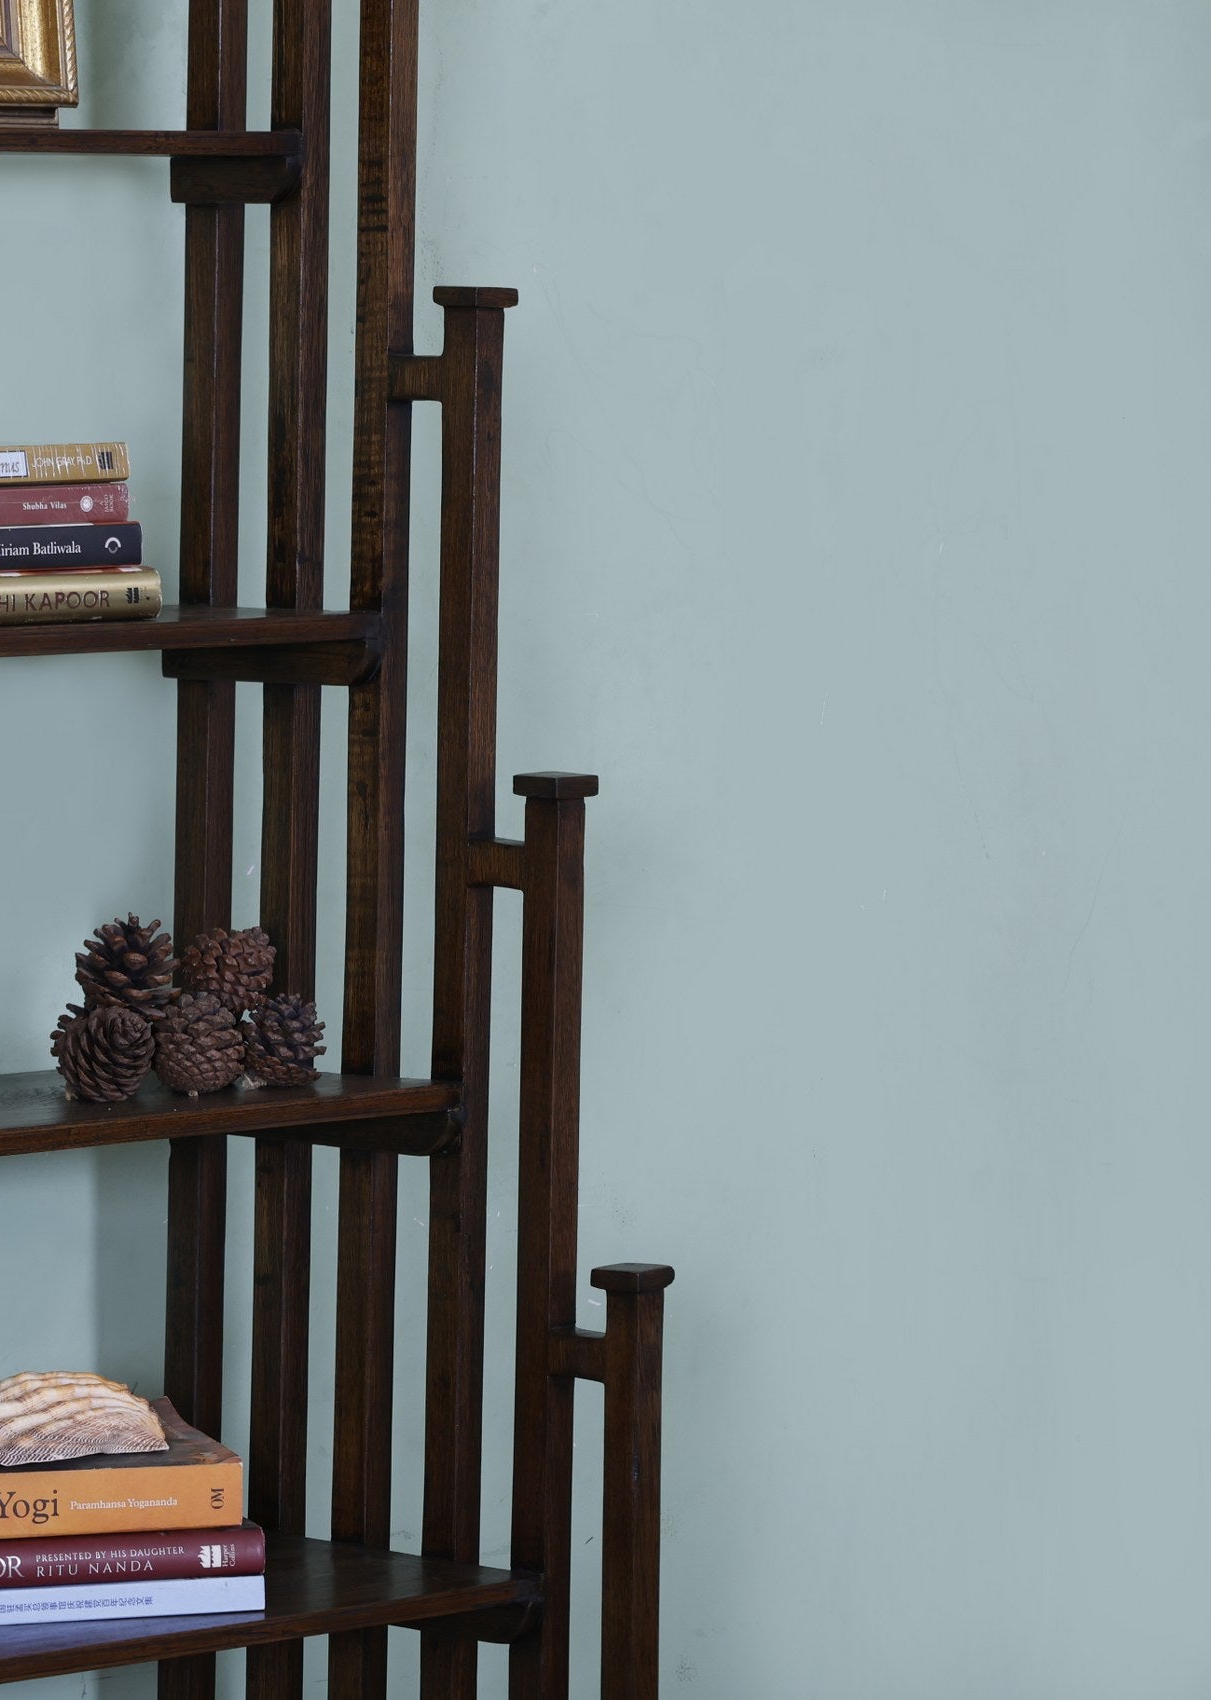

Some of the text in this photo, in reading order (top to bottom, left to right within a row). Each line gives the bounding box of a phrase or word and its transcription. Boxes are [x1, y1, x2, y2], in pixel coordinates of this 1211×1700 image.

[31, 456, 54, 468] JOHN
[55, 456, 75, 468] GRAY
[23, 501, 67, 511] Shubha Vilas
[33, 541, 81, 556] Batliwala
[25, 590, 111, 612] KAPOOR
[69, 1496, 178, 1510] Paramhansa Yogananda
[211, 1488, 225, 1510] OM
[35, 1545, 185, 1563] PRESENTED BY HIS DAUGHTER
[36, 1560, 154, 1577] RITU NANDA
